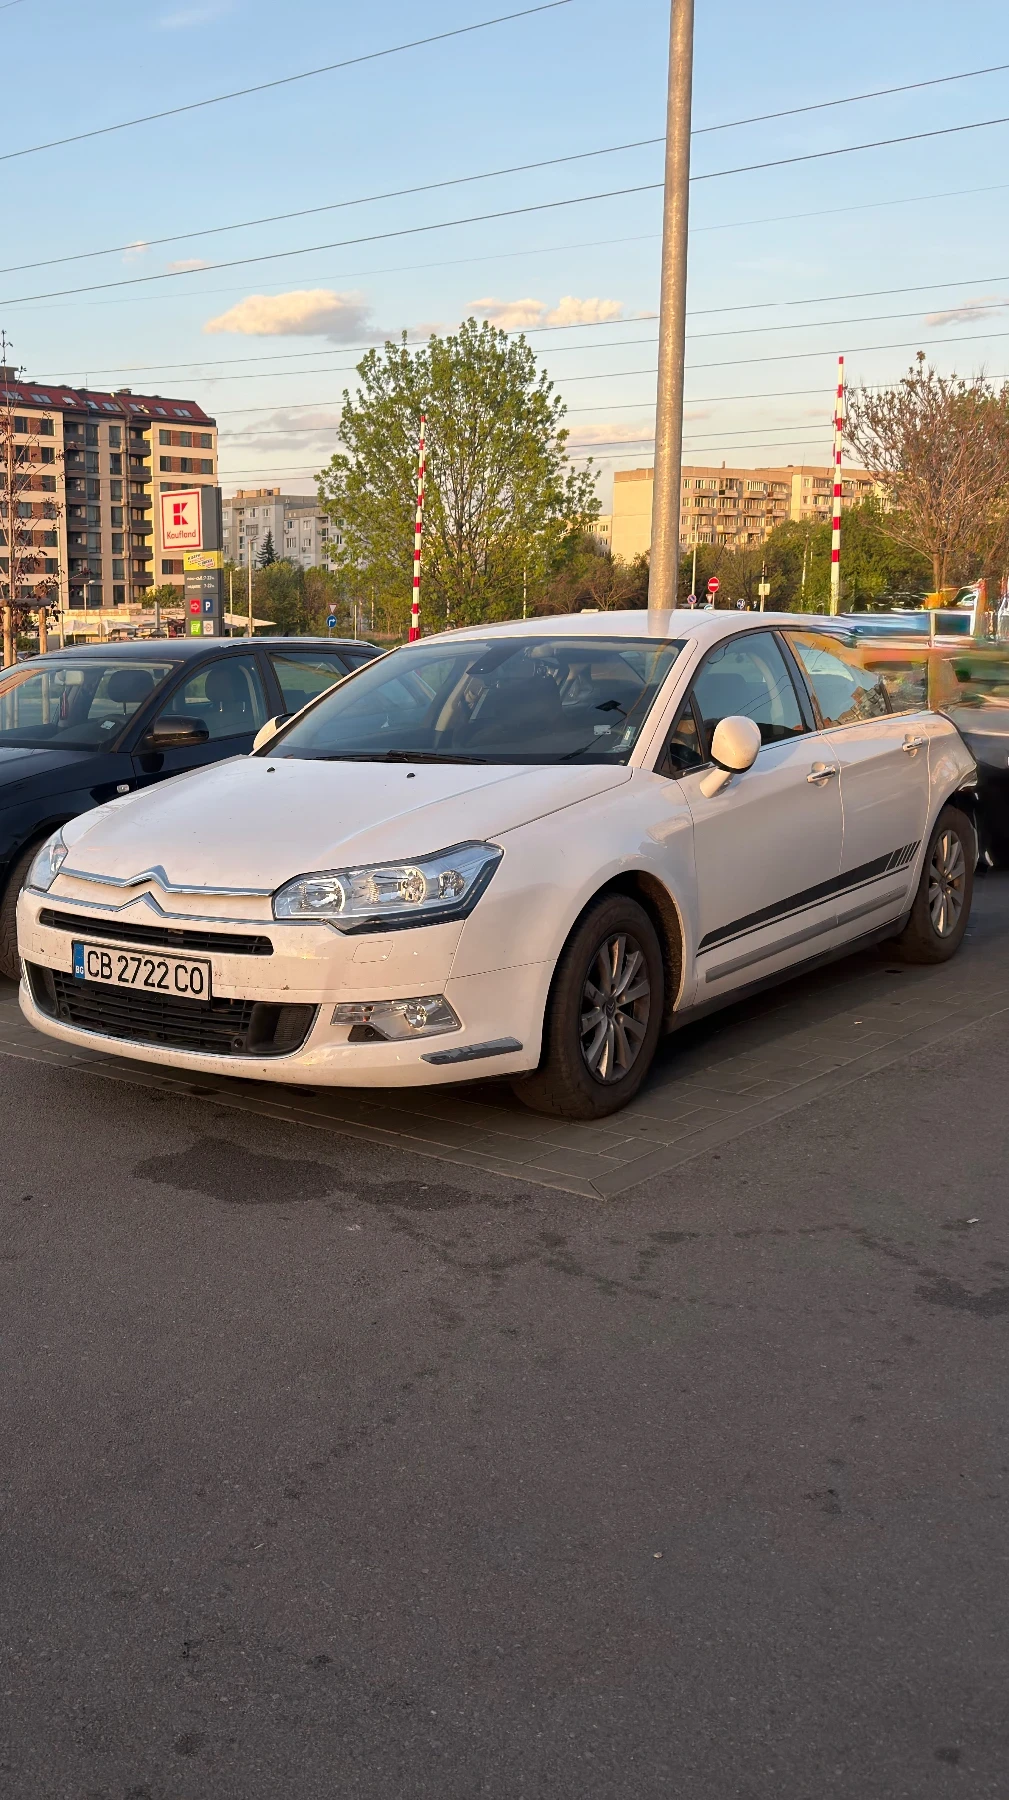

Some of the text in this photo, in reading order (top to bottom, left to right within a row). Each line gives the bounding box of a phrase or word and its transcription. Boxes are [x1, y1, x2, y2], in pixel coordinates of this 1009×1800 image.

[173, 502, 188, 526] K
[166, 529, 197, 540] Kaufland
[205, 601, 211, 611] P
[75, 965, 84, 974] BG
[87, 950, 204, 995] CB 2722 CO
